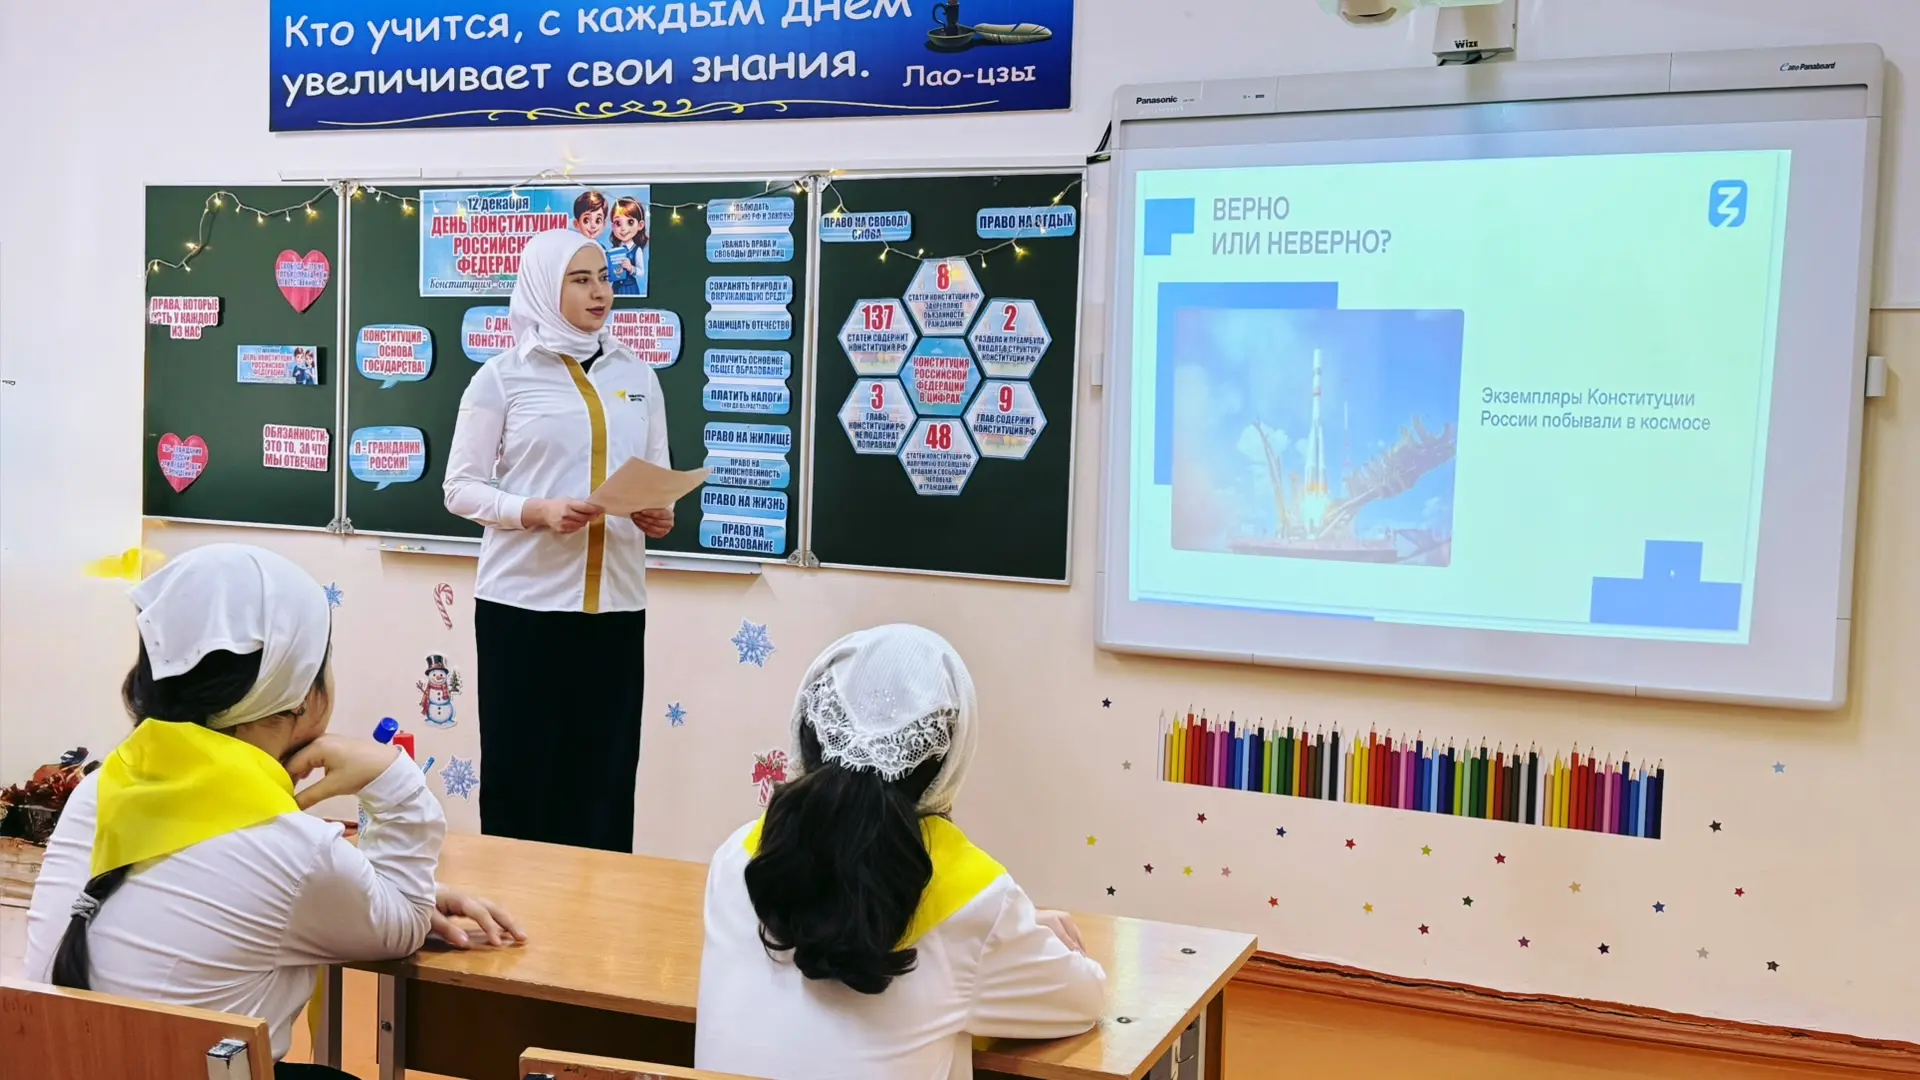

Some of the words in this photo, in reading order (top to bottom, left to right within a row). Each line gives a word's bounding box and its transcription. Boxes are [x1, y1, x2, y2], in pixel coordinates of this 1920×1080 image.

[285, 15, 354, 48] Кто
[367, 12, 523, 54] учится,
[539, 9, 560, 36] с
[578, 0, 765, 35] каждым
[282, 62, 551, 108] увеличивает
[568, 58, 672, 88] свои
[692, 50, 870, 82] знания.
[903, 64, 1036, 88] Лао-цзы
[1136, 96, 1178, 104] Panasonic
[468, 197, 478, 211] 12
[479, 197, 529, 213] декабря
[1213, 196, 1290, 221] ВЕРНО
[432, 217, 467, 236] ДЕНЬ
[471, 214, 568, 234] КОНСТИТУЦИИ
[823, 215, 853, 228] ПРАВО
[868, 214, 908, 228] СВОБОДУ
[980, 214, 1016, 230] ПРАВО
[1018, 214, 1033, 228] НА
[1035, 212, 1074, 228] ОТДЫХ
[722, 239, 750, 248] УВАЖАТЬ
[752, 239, 771, 248] ПРАВА
[1211, 231, 1260, 256] ИЛИ
[1267, 229, 1392, 256] НЕВЕРНО?
[714, 250, 745, 258] СВОБОДЫ
[747, 249, 771, 258] ДРУГИХ
[772, 249, 785, 258] ЛИЦ
[937, 264, 950, 290] 8
[709, 281, 750, 291] СОХРАНЯТЬ
[751, 281, 782, 291] ПРИРОДУ
[783, 282, 788, 290] И
[711, 292, 763, 302] ОКРУЖАЮЩУЮ
[765, 292, 786, 301] СРЕДУ
[153, 299, 182, 311] ПРАВА,
[183, 299, 218, 310] КОТОРЫЕ
[174, 312, 179, 323] У
[181, 312, 217, 325] КАЖДОГО
[485, 317, 492, 330] С
[614, 313, 638, 323] НАША
[639, 313, 660, 324] СИЛА
[862, 305, 894, 330] 137
[1003, 305, 1017, 331] 2
[708, 320, 750, 330] ЗАЩИЩАТЬ
[751, 320, 790, 330] ОТЕЧЕСТВО
[172, 326, 182, 337] ИЗ
[184, 326, 200, 337] НАС
[363, 330, 422, 343] КОНСТИТУЦИЯ
[656, 326, 674, 337] НАШ
[873, 333, 909, 342] СОДЕРЖИТ
[379, 345, 413, 357] ОСНОВА
[849, 343, 896, 352] КОНСТИТУЦИЯ
[897, 343, 907, 352] РФ
[710, 354, 747, 364] ПОЛУЧИТЬ
[748, 356, 783, 365] ОСНОВНОЕ
[913, 357, 970, 369] КОНСТИТУЦИЯ
[364, 360, 425, 374] ГОСУДАРСТВА!
[710, 364, 734, 374] ОБЩЕЕ
[736, 366, 783, 375] ОБРАЗОВАНИЕ
[915, 368, 967, 380] РОССИЙСКОЙ
[916, 381, 965, 393] ФЕДЕРАЦИИ
[711, 390, 749, 401] ПЛАТИТЬ
[751, 392, 782, 402] НАЛОГИ
[871, 384, 884, 410] 3
[920, 393, 925, 403] В
[927, 393, 960, 404] ЦИФРАХ
[999, 386, 1012, 412] 9
[1481, 387, 1582, 408] Экземпляры
[1587, 388, 1695, 410] Конституции
[977, 414, 995, 423] ГЛАВ
[996, 415, 1035, 425] СОДЕРЖИТ
[1481, 410, 1537, 427] России
[1542, 412, 1622, 429] побывали
[1627, 417, 1636, 429] в
[1640, 416, 1711, 431] космосе
[849, 422, 894, 430] КОНСТИТУЦИИ
[974, 425, 1024, 435] КОНСТИТУЦИЯ
[1024, 428, 1036, 436] РФ
[705, 430, 734, 442] ПРАВО
[737, 432, 747, 443] НА
[750, 432, 790, 446] ЖИЛИЩЕ
[864, 432, 899, 440] ПОДЛЕЖАТ
[926, 424, 952, 450] 48
[265, 440, 281, 453] ЭТО
[300, 442, 311, 454] ЗА
[311, 443, 327, 455] ЧТО
[355, 442, 361, 453] Я
[368, 441, 421, 455] ГРАЖДАНИН
[265, 454, 282, 466] МЫ
[284, 455, 326, 470] ОТВЕЧАЕМ
[369, 457, 408, 469] РОССИИ!
[730, 458, 751, 467] ПРАВО
[751, 460, 760, 468] НА
[748, 478, 770, 486] ЖИЗНИ
[704, 493, 736, 506] ПРАВО
[739, 495, 751, 508] НА
[752, 496, 785, 511] ЖИЗНЬ
[722, 523, 751, 537] ПРАВО
[753, 525, 765, 538] НА
[711, 536, 774, 552] ОБРАЗОВАНИЕ
